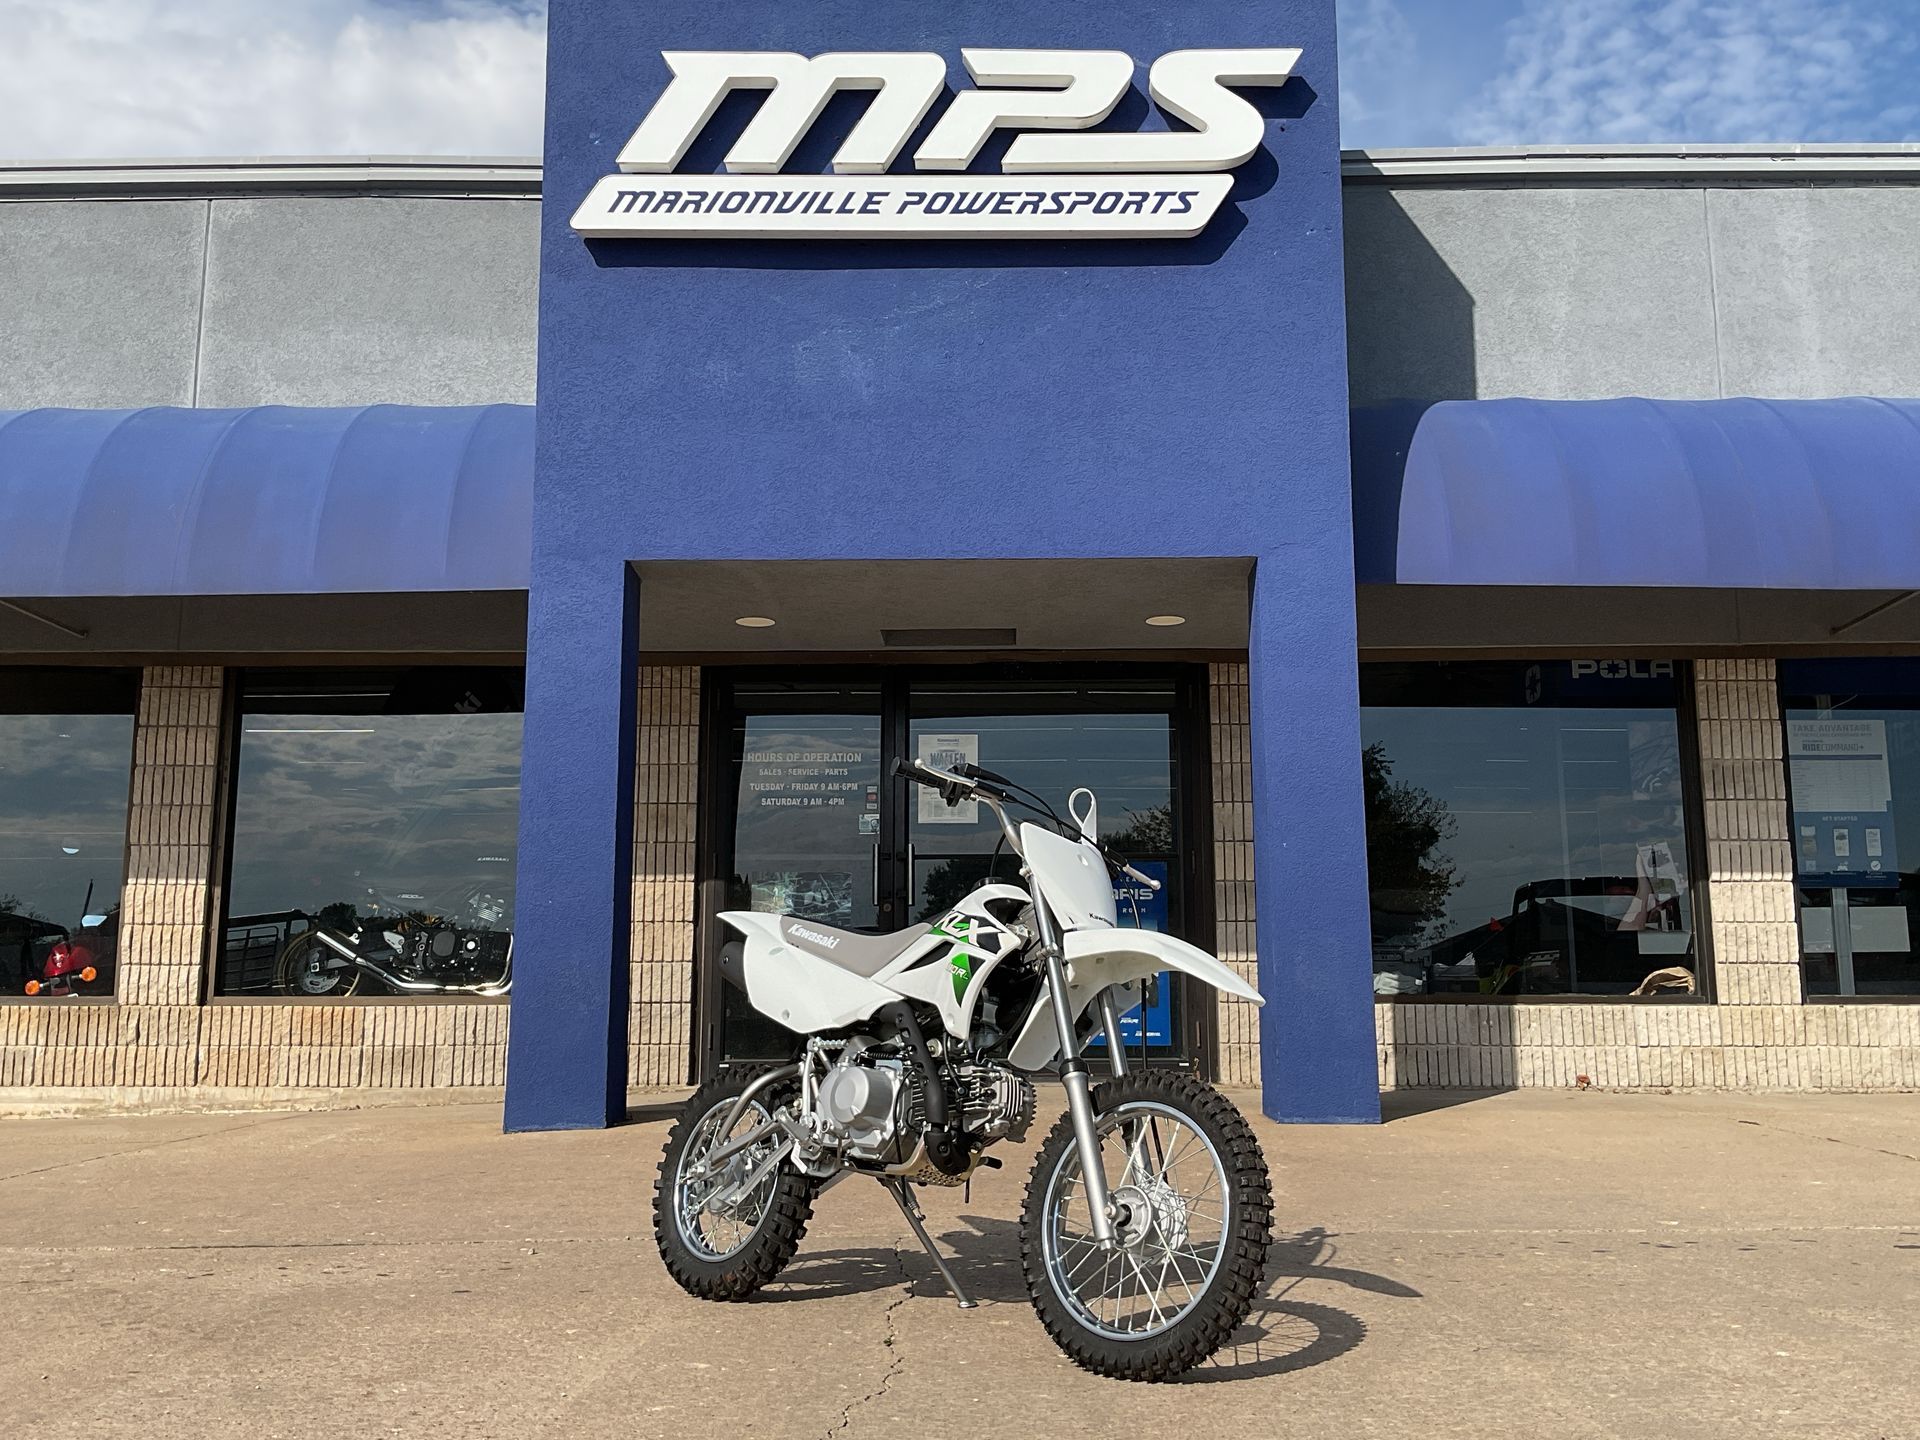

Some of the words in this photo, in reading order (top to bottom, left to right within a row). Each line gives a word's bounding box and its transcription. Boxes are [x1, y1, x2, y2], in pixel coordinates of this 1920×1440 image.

[614, 48, 1304, 174] MPS
[607, 190, 891, 214] MARIONVILLE
[896, 191, 1200, 214] POWERSPORTS
[747, 752, 783, 762] HOURS
[786, 752, 800, 762] OF
[803, 752, 862, 762] OPERATION
[759, 768, 782, 776] SALES
[788, 768, 819, 776] SERVICE
[824, 768, 848, 776] PARTS
[749, 783, 785, 791] TUESDAY
[791, 783, 819, 791] FRIDAY
[820, 783, 826, 791] 9
[761, 798, 801, 806] SATURDAY
[803, 798, 808, 806] 9
[809, 798, 822, 806] AM
[828, 798, 845, 806] 4PM
[787, 923, 840, 949] Kawasaki
